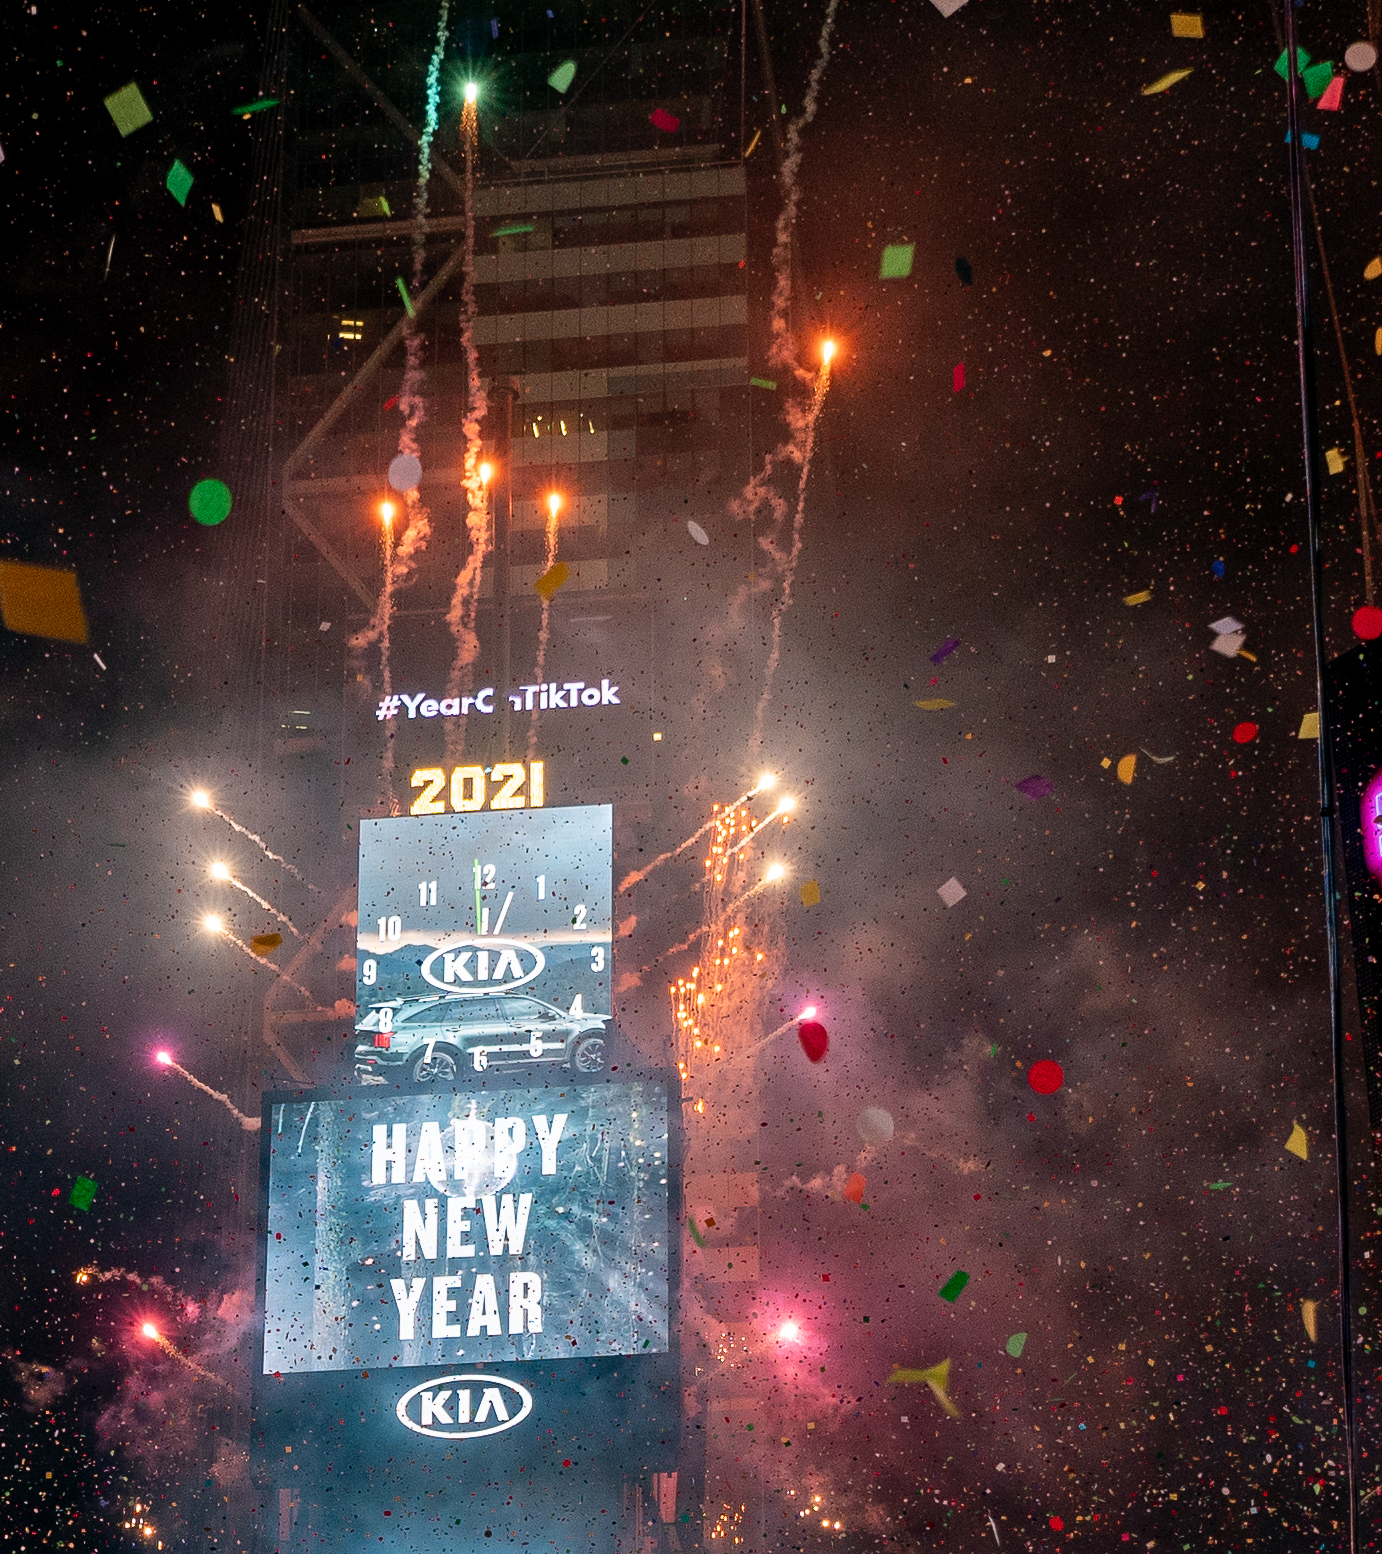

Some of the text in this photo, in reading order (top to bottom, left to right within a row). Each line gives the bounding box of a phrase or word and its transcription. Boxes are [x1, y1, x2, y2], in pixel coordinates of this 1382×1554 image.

[409, 760, 544, 815] 2021
[472, 863, 496, 890] 12
[535, 875, 546, 899] 1
[418, 881, 438, 905] 11
[378, 916, 402, 941] 10
[573, 905, 588, 929] 2
[362, 959, 377, 985] 9
[443, 950, 526, 983] KIA
[590, 947, 605, 972] 3
[378, 1007, 393, 1033] 8
[568, 994, 584, 1020] 4
[423, 1037, 435, 1063] 7
[529, 1032, 543, 1057] 5
[473, 1045, 488, 1071] 6
[370, 1113, 568, 1185] HAPPY
[402, 1193, 533, 1261] NEW
[390, 1271, 544, 1341] YEAR
[420, 1389, 510, 1427] KIA
